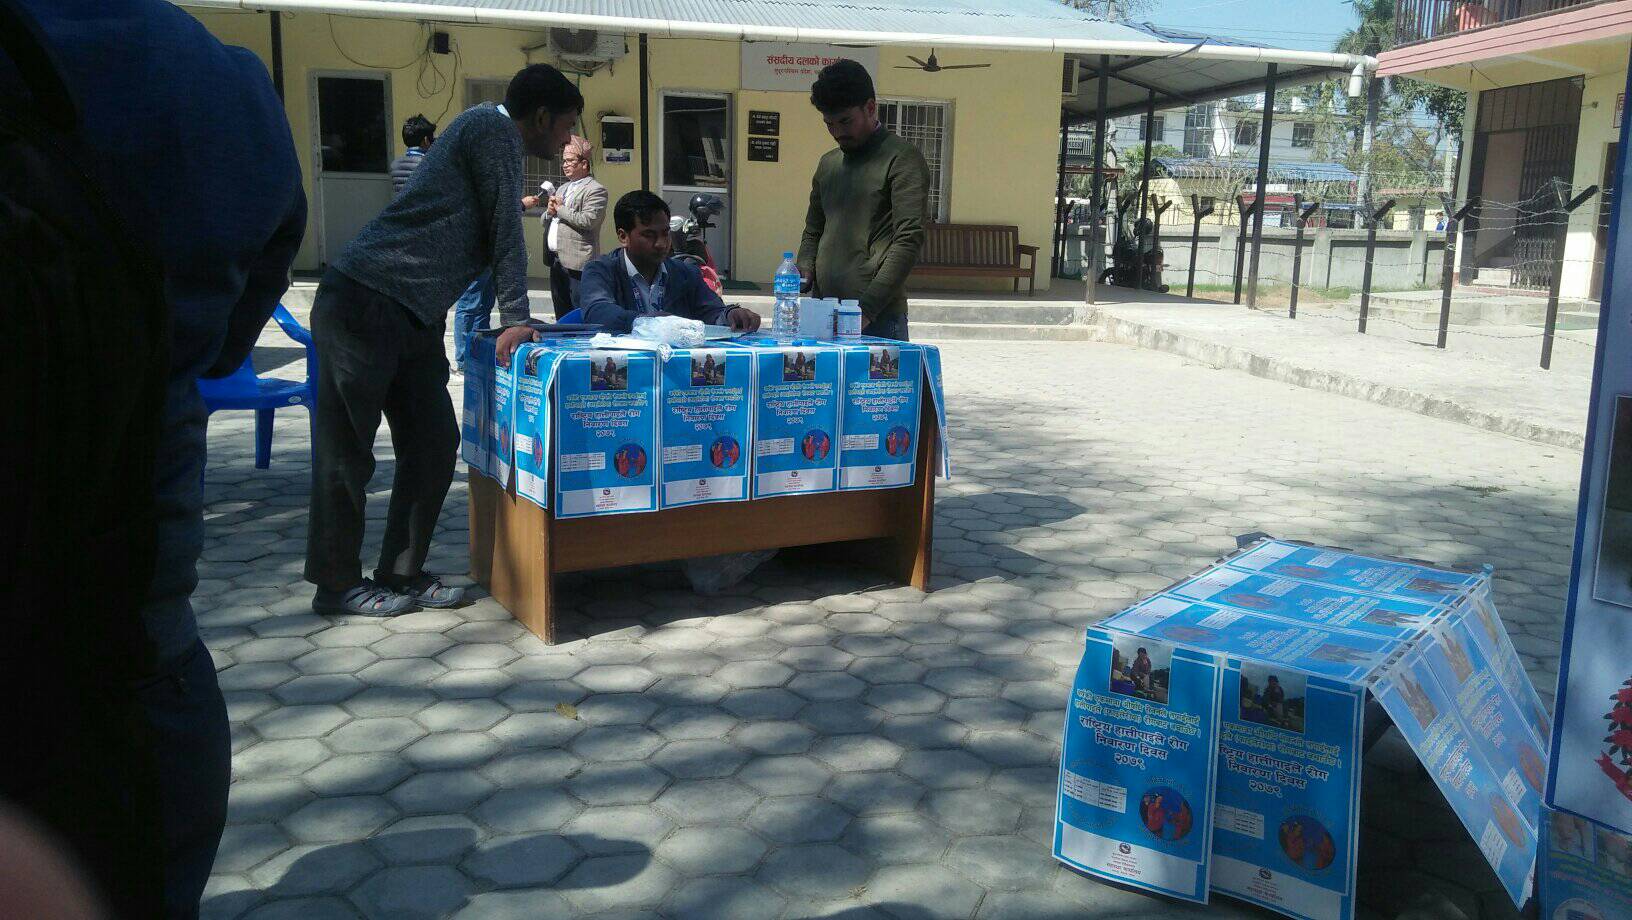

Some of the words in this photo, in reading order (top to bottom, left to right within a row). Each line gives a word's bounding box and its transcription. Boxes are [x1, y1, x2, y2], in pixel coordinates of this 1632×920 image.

[1080, 716, 1112, 733] राष्ट्रिय
[1114, 724, 1166, 745] हात्तीपाइले
[1167, 735, 1190, 750] रोग
[1095, 733, 1137, 752] निवारण
[1139, 742, 1168, 760] दिवस
[1219, 744, 1245, 761] ष्ट्रिय
